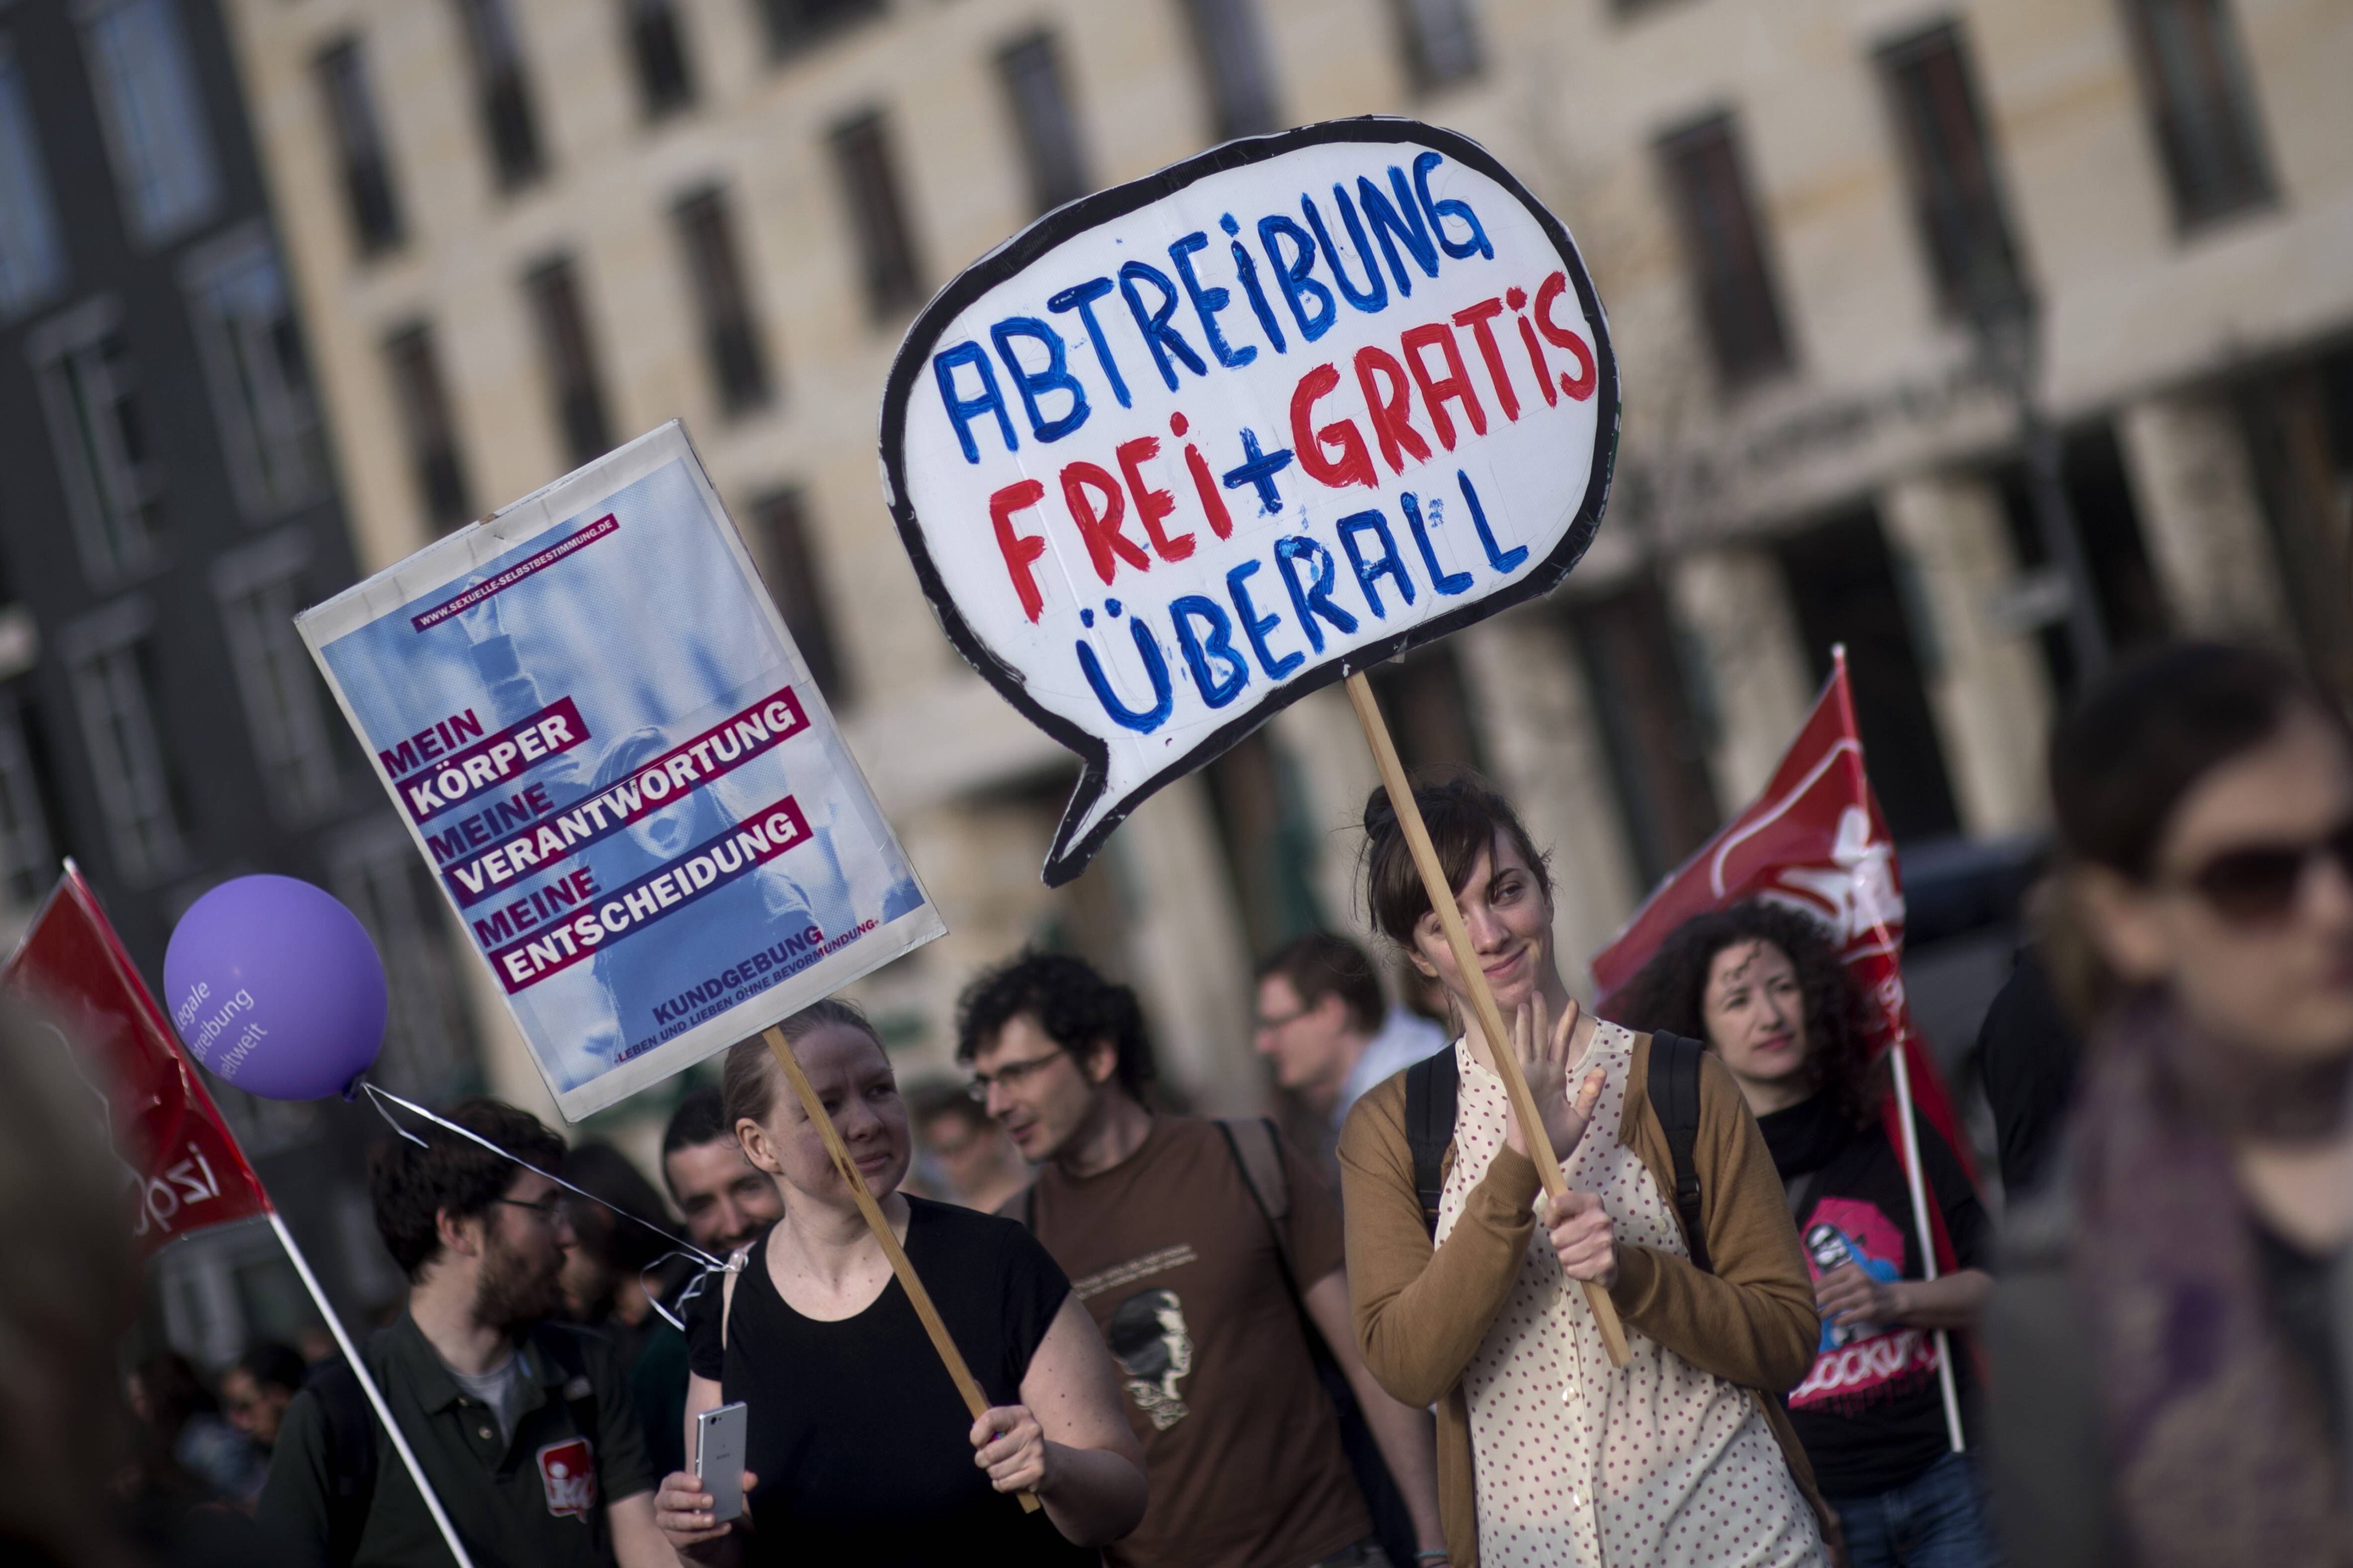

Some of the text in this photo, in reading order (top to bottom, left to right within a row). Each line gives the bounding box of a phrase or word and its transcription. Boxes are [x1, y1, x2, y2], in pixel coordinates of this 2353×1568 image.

[419, 519, 613, 626] WWW.SEXUELLE-SELBSTBESTIMMUNG.DE
[1076, 469, 1527, 734] ÜBERALL
[378, 708, 485, 779] MEIN
[408, 715, 575, 816] KÖRPER
[426, 781, 555, 865] MEINE
[453, 701, 796, 894] VERANTWORTUNG
[473, 865, 602, 948] MEINE
[502, 812, 798, 983] ENTSCHEIDUNG
[174, 981, 211, 1033] Legale
[652, 925, 824, 1026] KUNDGEBUNG
[659, 1021, 687, 1040] UND
[689, 996, 733, 1025] LIEBEN
[736, 976, 771, 1001] OHNE
